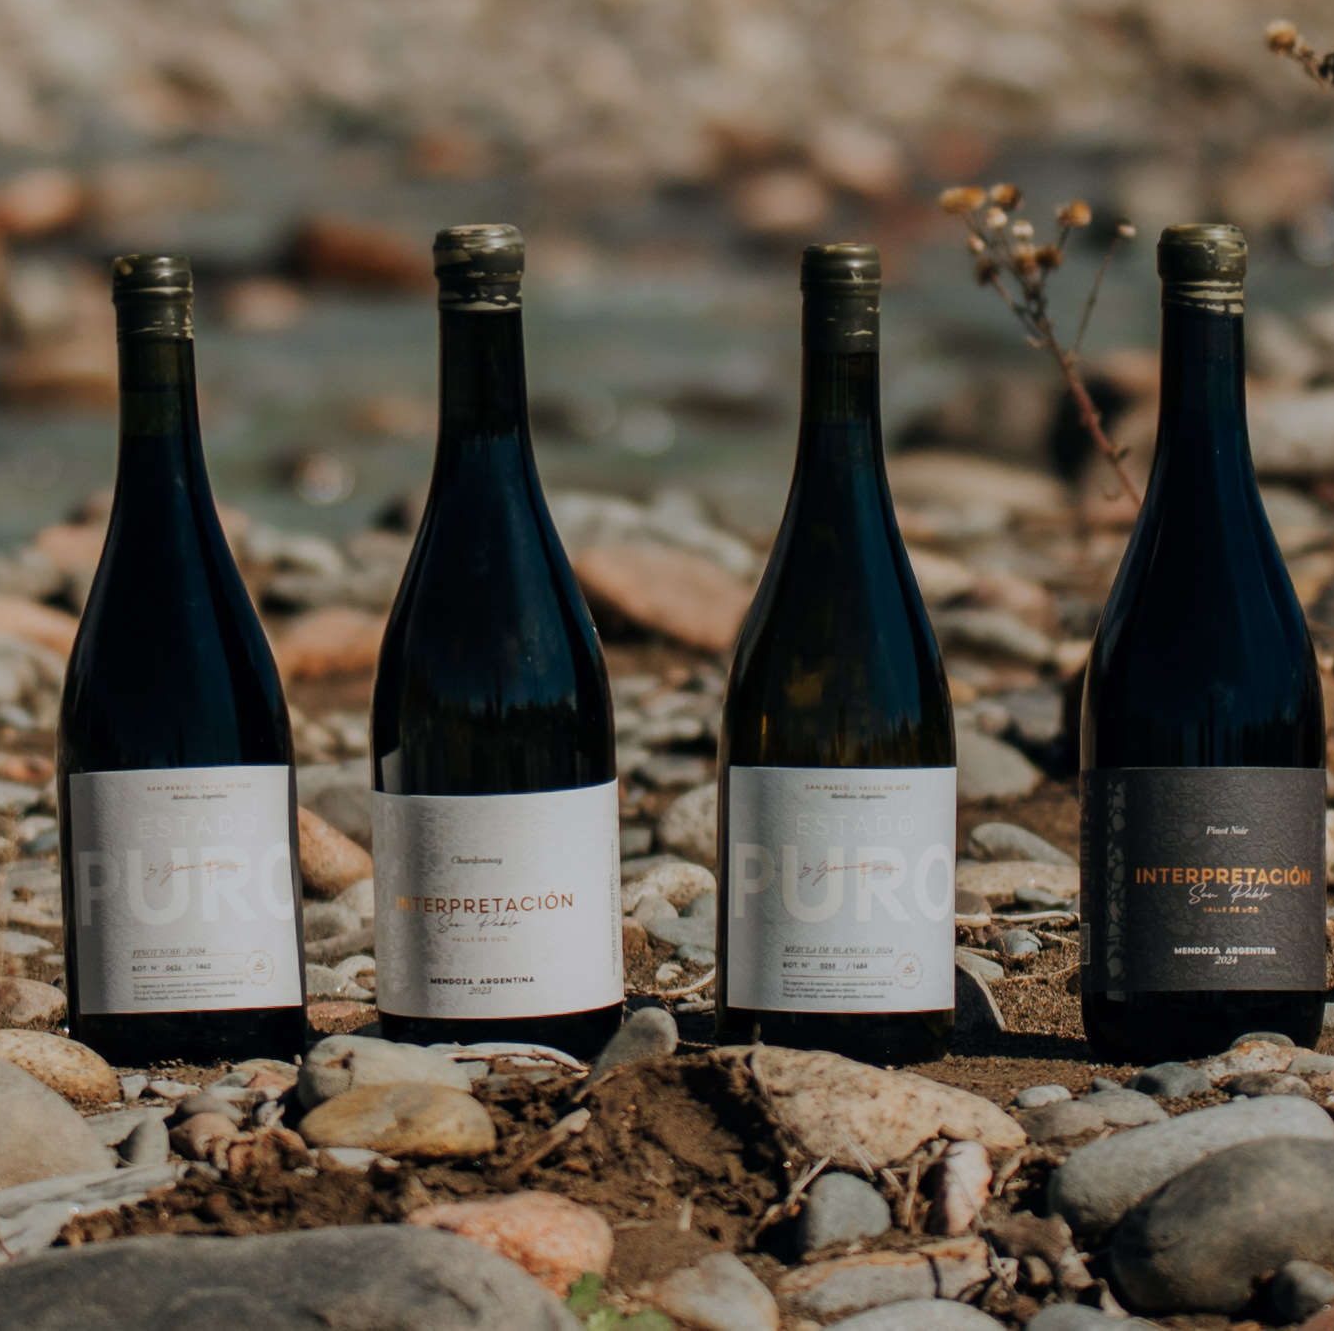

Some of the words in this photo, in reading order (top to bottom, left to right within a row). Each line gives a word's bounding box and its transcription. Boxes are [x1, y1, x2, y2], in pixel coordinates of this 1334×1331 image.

[796, 814, 915, 837] ESTADO
[1206, 825, 1228, 836] Pinot
[1230, 825, 1249, 835] Noir
[451, 855, 503, 866] Chardonnay
[734, 842, 952, 923] PURO
[1136, 865, 1311, 885] INTERPRETACIÓN
[78, 842, 295, 926] PURO
[1189, 882, 1219, 905] San
[1228, 881, 1273, 903] Pablo
[395, 891, 574, 913] INTERPRETACIÓN
[1174, 946, 1221, 955] MENDOZA
[1225, 946, 1277, 955] ARGENTINA
[1214, 955, 1238, 965] 2024
[430, 977, 474, 985] MENDOZA
[479, 976, 535, 985] ARGENTINA
[469, 986, 492, 995] 2023
